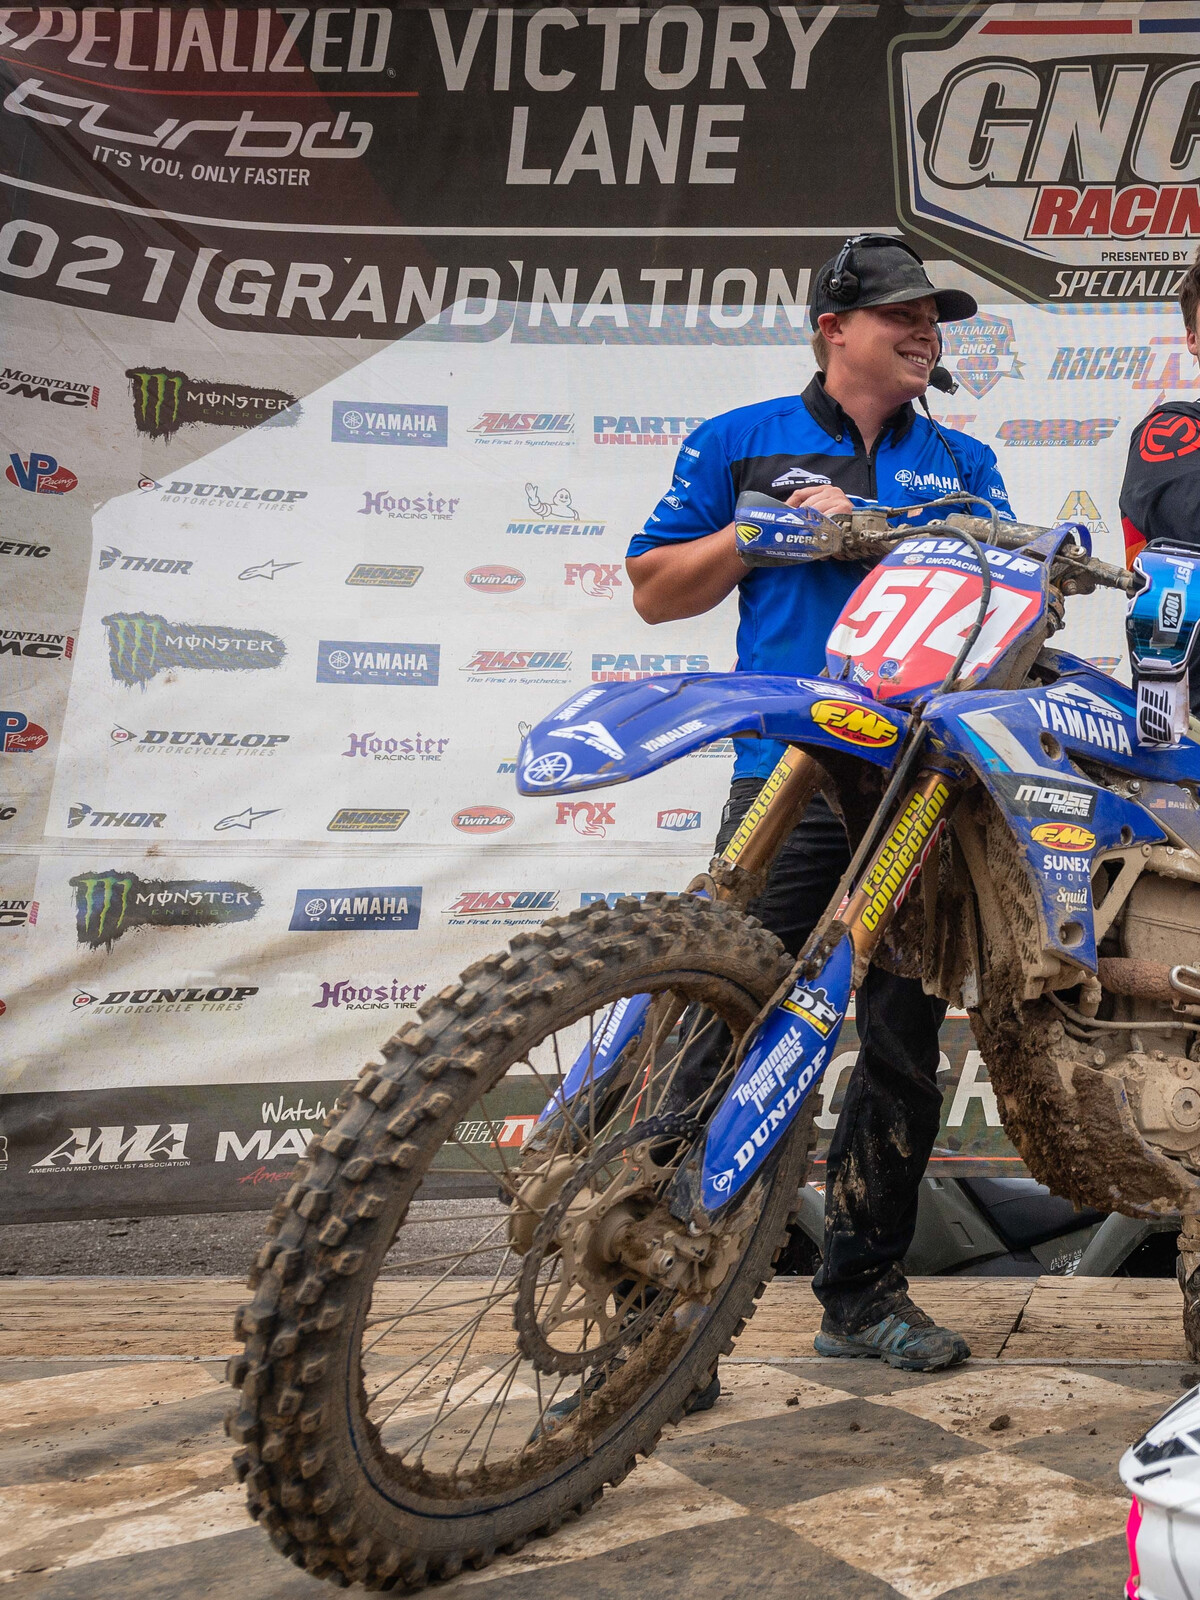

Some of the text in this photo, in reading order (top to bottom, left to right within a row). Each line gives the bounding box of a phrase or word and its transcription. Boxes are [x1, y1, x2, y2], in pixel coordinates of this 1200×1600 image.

[429, 6, 840, 92] VICTORY
[2, 78, 374, 158] turbo
[506, 104, 745, 185] LANE
[92, 145, 311, 187] IT'S YOU, ONLY FASTER
[1101, 251, 1188, 262] PRESENTED BY
[0, 219, 812, 327] 021 GRAND NATION
[949, 326, 1006, 335] SPECIALIZED
[959, 343, 996, 354] GNCC
[1, 367, 91, 394] MOUNTAIN
[187, 390, 291, 412] MONSTER
[365, 412, 437, 432] YAMAHA
[474, 411, 575, 433] AMSOIL
[593, 416, 708, 434] PARTS
[350, 429, 433, 439] RACING
[9, 452, 59, 492] VP
[39, 476, 77, 492] Racing
[165, 481, 308, 504] DUNLOP
[160, 494, 296, 512] MOTORCYCLE TIRES
[357, 490, 460, 515] Hoosier
[749, 510, 776, 521] YAMAHA
[505, 523, 606, 536] MICHELIN
[120, 556, 194, 576] THOR
[893, 540, 1040, 577] BAYLOR
[925, 557, 1005, 581] GNCCRACINGCOM
[470, 573, 523, 585] Twin Air
[1165, 556, 1195, 585] 1ST
[1163, 592, 1182, 628] 100%
[830, 567, 1040, 680] 514
[165, 634, 275, 653] MONSTER
[352, 651, 428, 671] YAMAHA
[466, 650, 572, 671] AMSOIL
[591, 654, 710, 671] PARTS
[813, 703, 899, 740] FMF
[1028, 697, 1134, 757] YAMAHA
[139, 730, 290, 748] DUNLOP
[341, 731, 450, 758] Hoosier
[640, 720, 708, 753] YAMALUBE
[134, 745, 277, 757] MOTORCYCLE TIRES
[1014, 784, 1094, 808] MOOSE
[90, 813, 167, 829] THOR
[338, 811, 406, 825] MOOSE
[458, 814, 513, 827] Twin Air
[555, 801, 616, 828] FOX
[660, 812, 698, 828] 100%
[1031, 825, 1096, 848] FMF
[1043, 855, 1091, 873] SUNEX
[1044, 872, 1091, 883] TOOLS
[136, 889, 251, 907] MONSTER
[329, 896, 409, 915] YAMAHA
[446, 890, 560, 913] AMSOIL
[1056, 886, 1088, 912] Squid
[309, 914, 403, 922] RACING
[100, 986, 259, 1005] DUNLOP
[311, 978, 428, 1009] Hoosier
[93, 1002, 244, 1015] MOTORCYCLE TIRES
[790, 984, 841, 1026] DP
[731, 1026, 802, 1104] TRAMMELL
[751, 1043, 805, 1114] TIRE PROS
[262, 1096, 330, 1123] Watch
[733, 1046, 827, 1171] DUNLOP
[31, 1123, 191, 1167] AMA
[28, 1160, 191, 1174] AMERICAN MOTORCYCLIST ASSOCIATION
